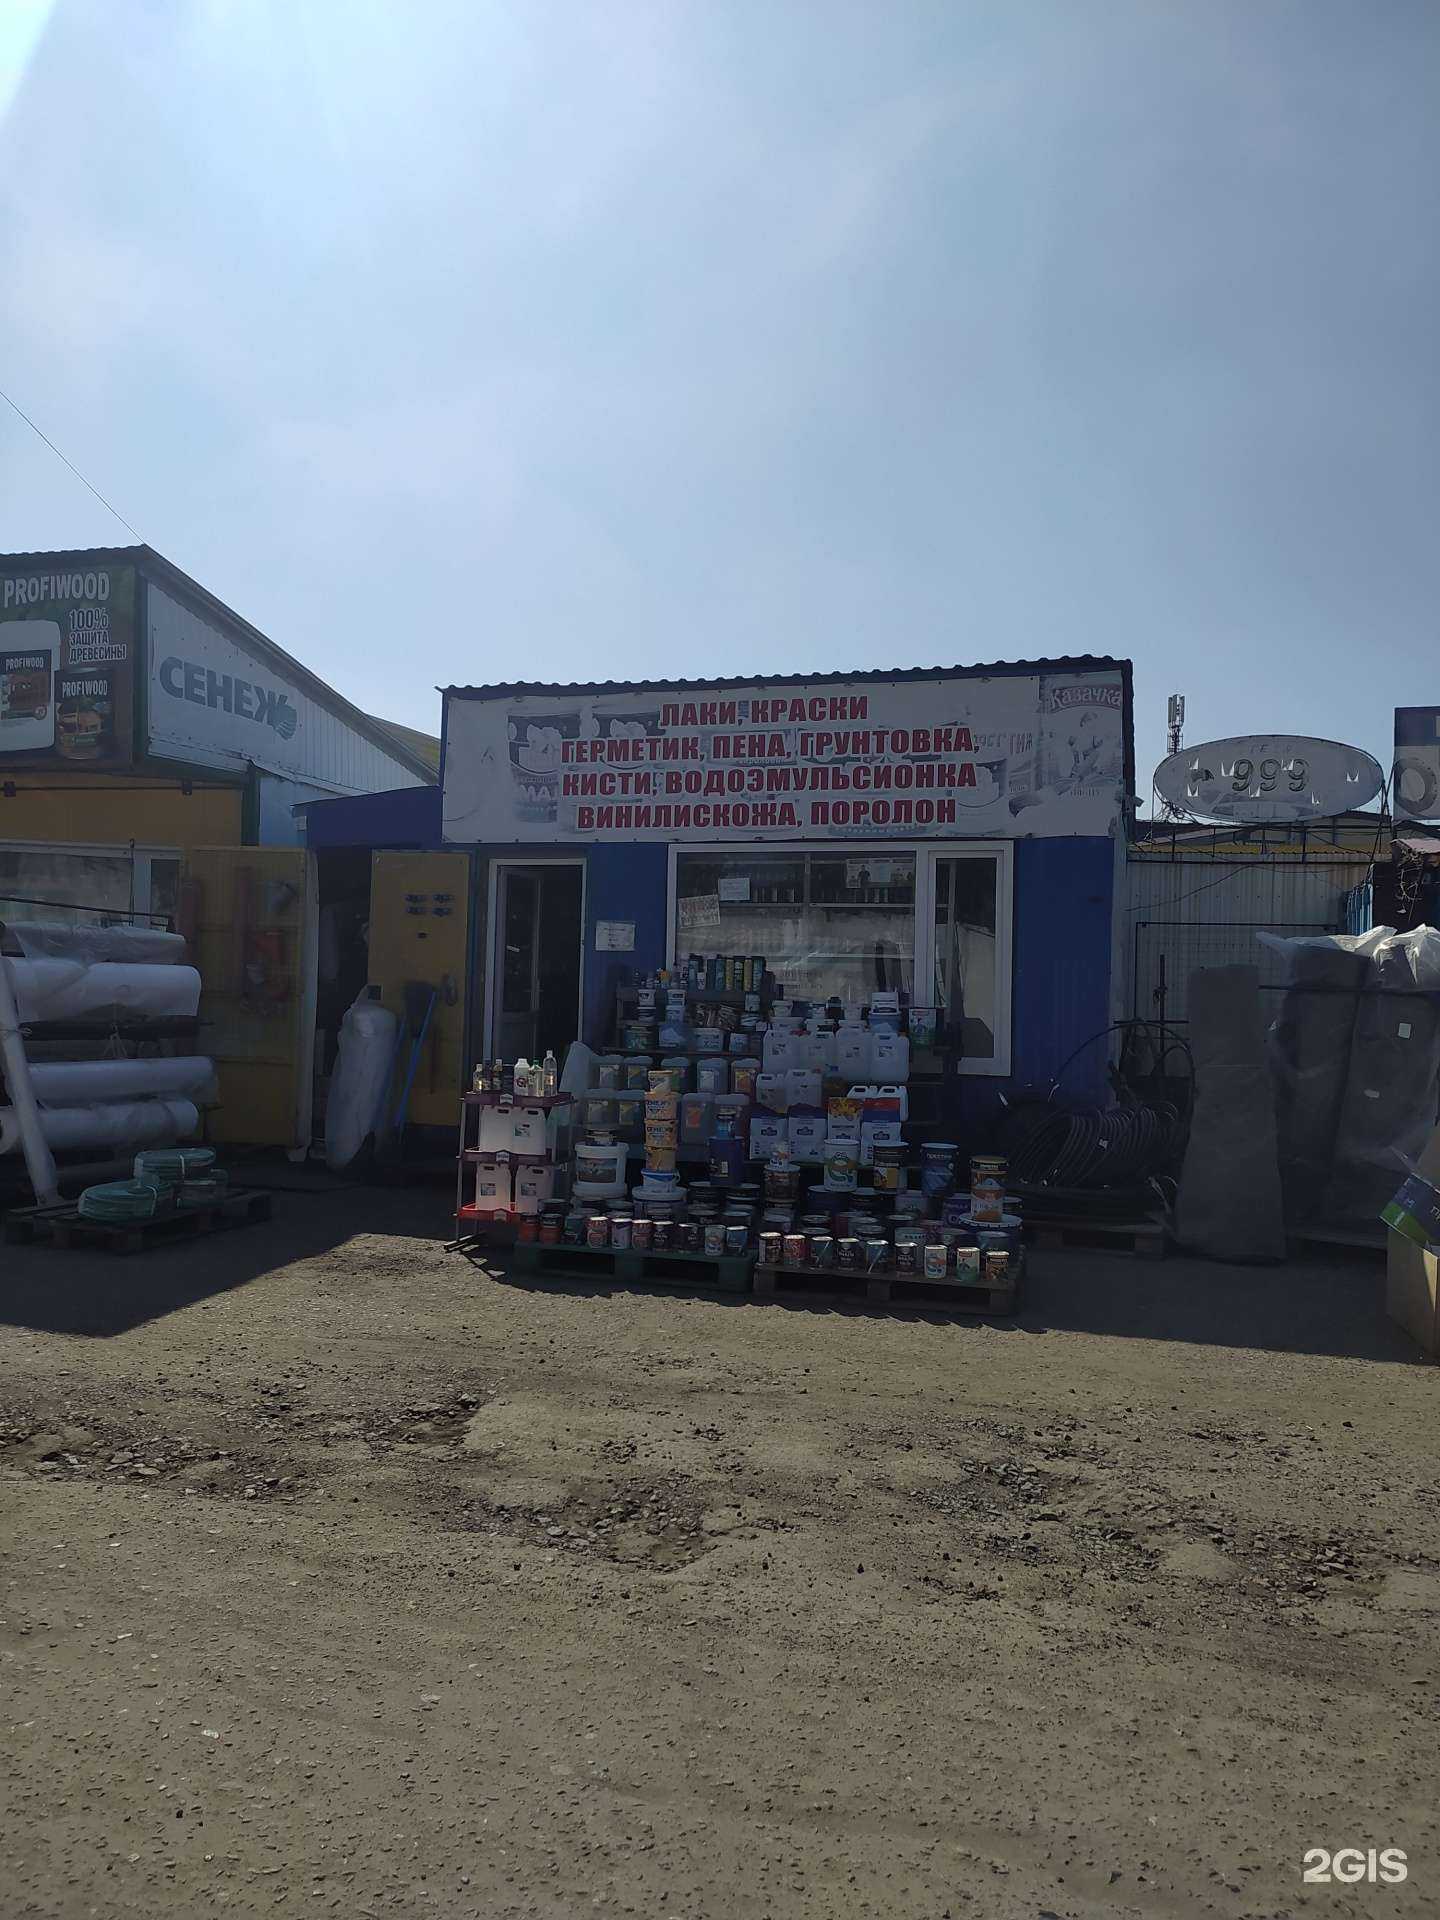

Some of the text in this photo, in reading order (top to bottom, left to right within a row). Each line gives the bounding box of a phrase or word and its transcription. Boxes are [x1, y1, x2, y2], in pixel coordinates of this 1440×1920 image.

[4, 571, 111, 608] PROFIWOOD
[69, 607, 109, 631] 100%
[69, 630, 110, 646] ЗАЩИТА
[68, 644, 127, 664] ДРЕВЕСИНЫ
[61, 678, 109, 699] PROFIWOOD
[159, 656, 288, 729] СЕНЕЖ
[660, 695, 868, 727] ЛАКИ, КРАСКИ
[561, 736, 705, 763] ГЕРМЕТИК,
[712, 733, 791, 759] ПЕНА,
[801, 726, 980, 756] ГРУНТОВКА,
[562, 771, 657, 796] КИСТИ,
[666, 763, 977, 796] ВОДОЭМУЛЬСИОНКА
[577, 799, 956, 829] ВИНИЛИСКОЖА, ПОРОЛОН
